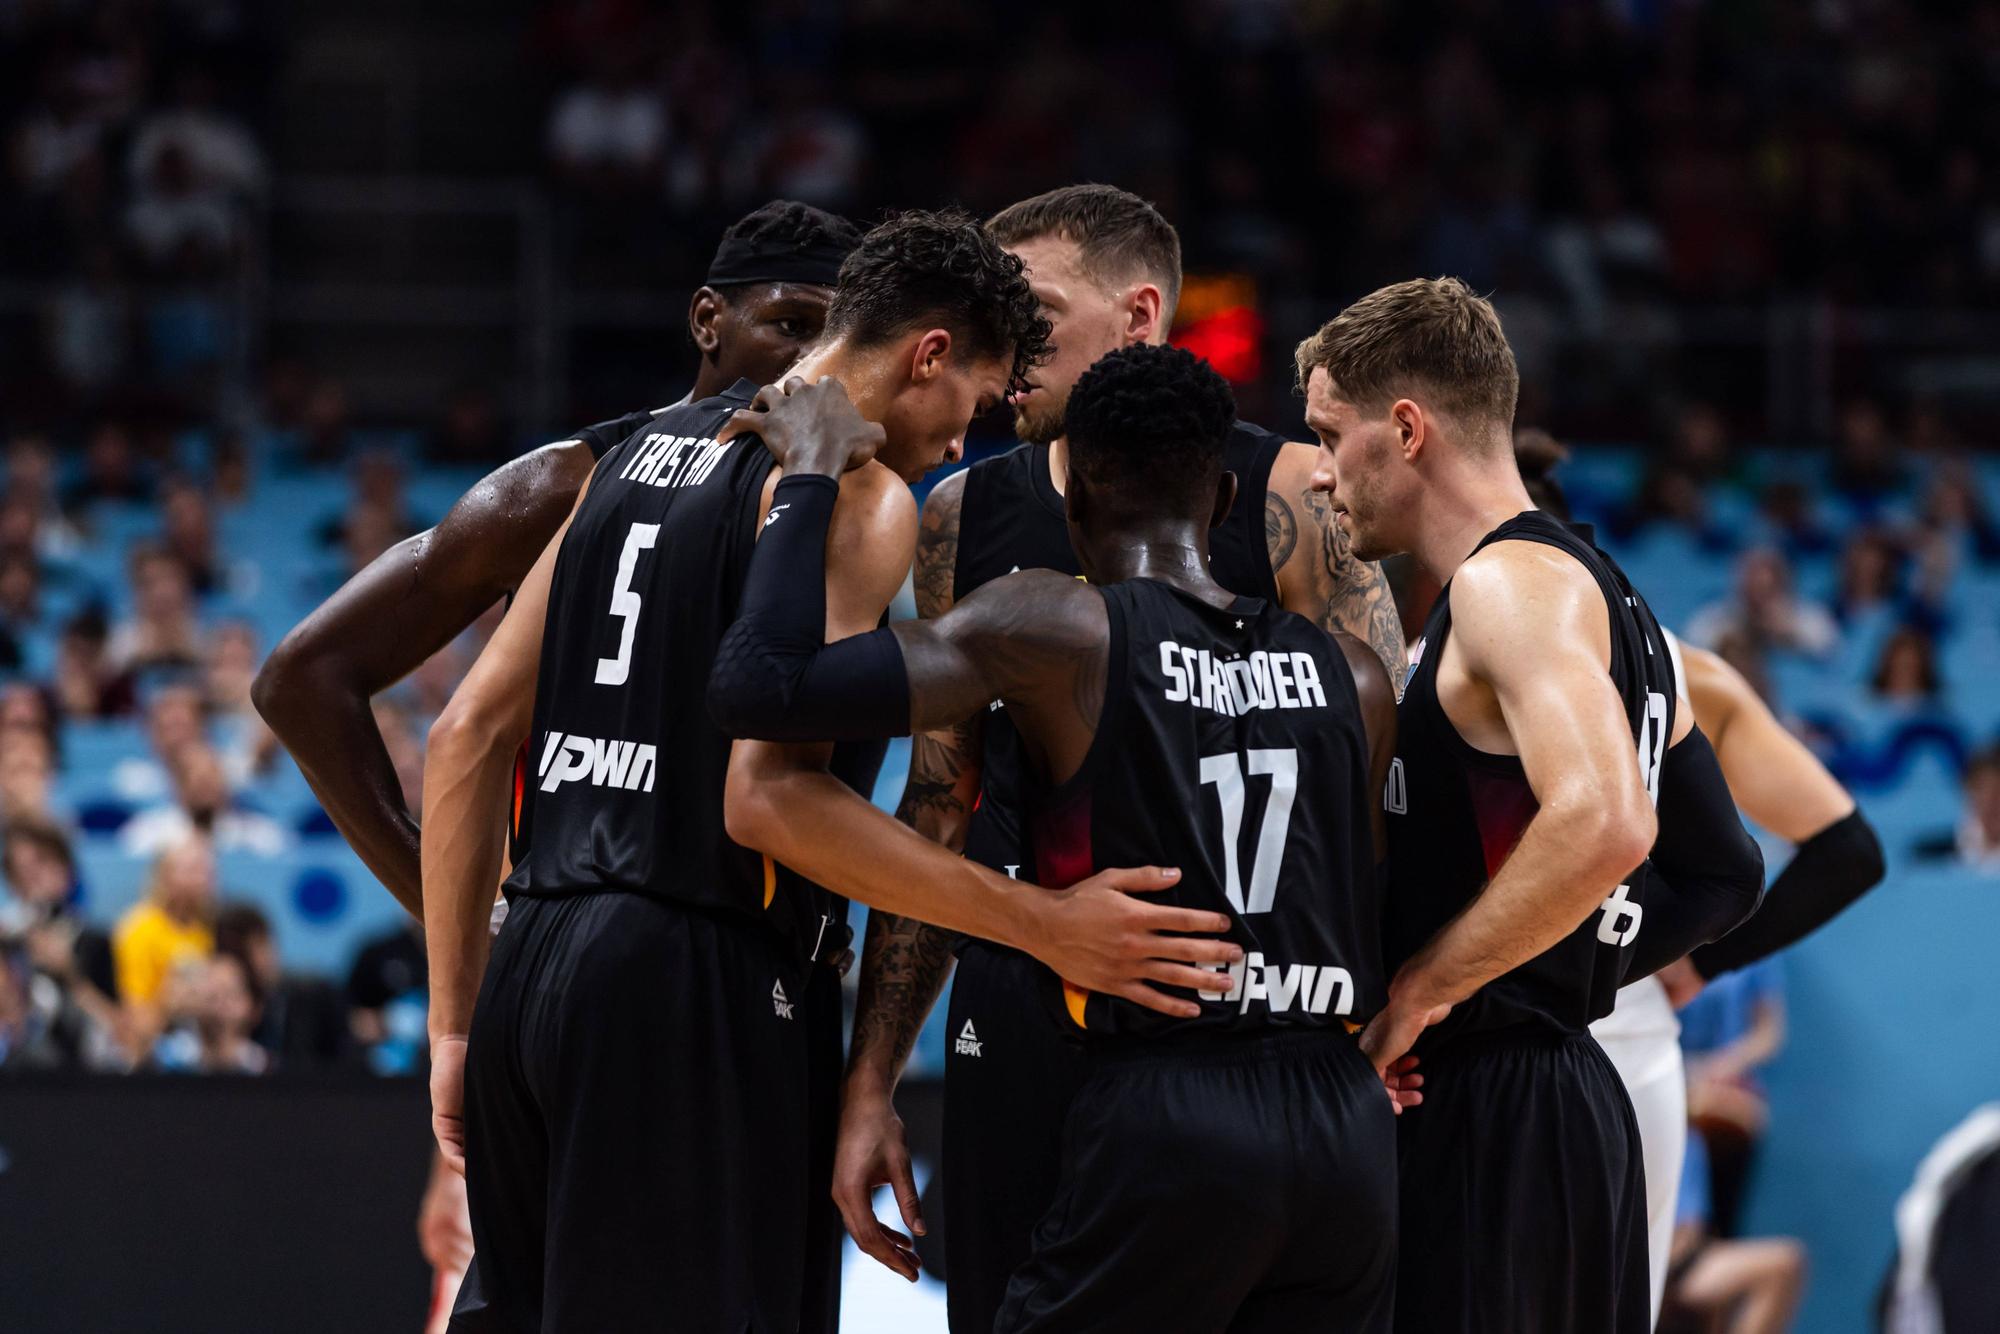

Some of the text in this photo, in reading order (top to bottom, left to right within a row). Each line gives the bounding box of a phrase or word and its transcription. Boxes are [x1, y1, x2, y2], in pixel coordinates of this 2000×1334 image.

[619, 433, 737, 488] TRISTAN
[594, 522, 661, 685] 5
[1159, 641, 1328, 717] SCHRÖDER
[1200, 748, 1298, 914] 17
[955, 1038, 983, 1058] PEAK
